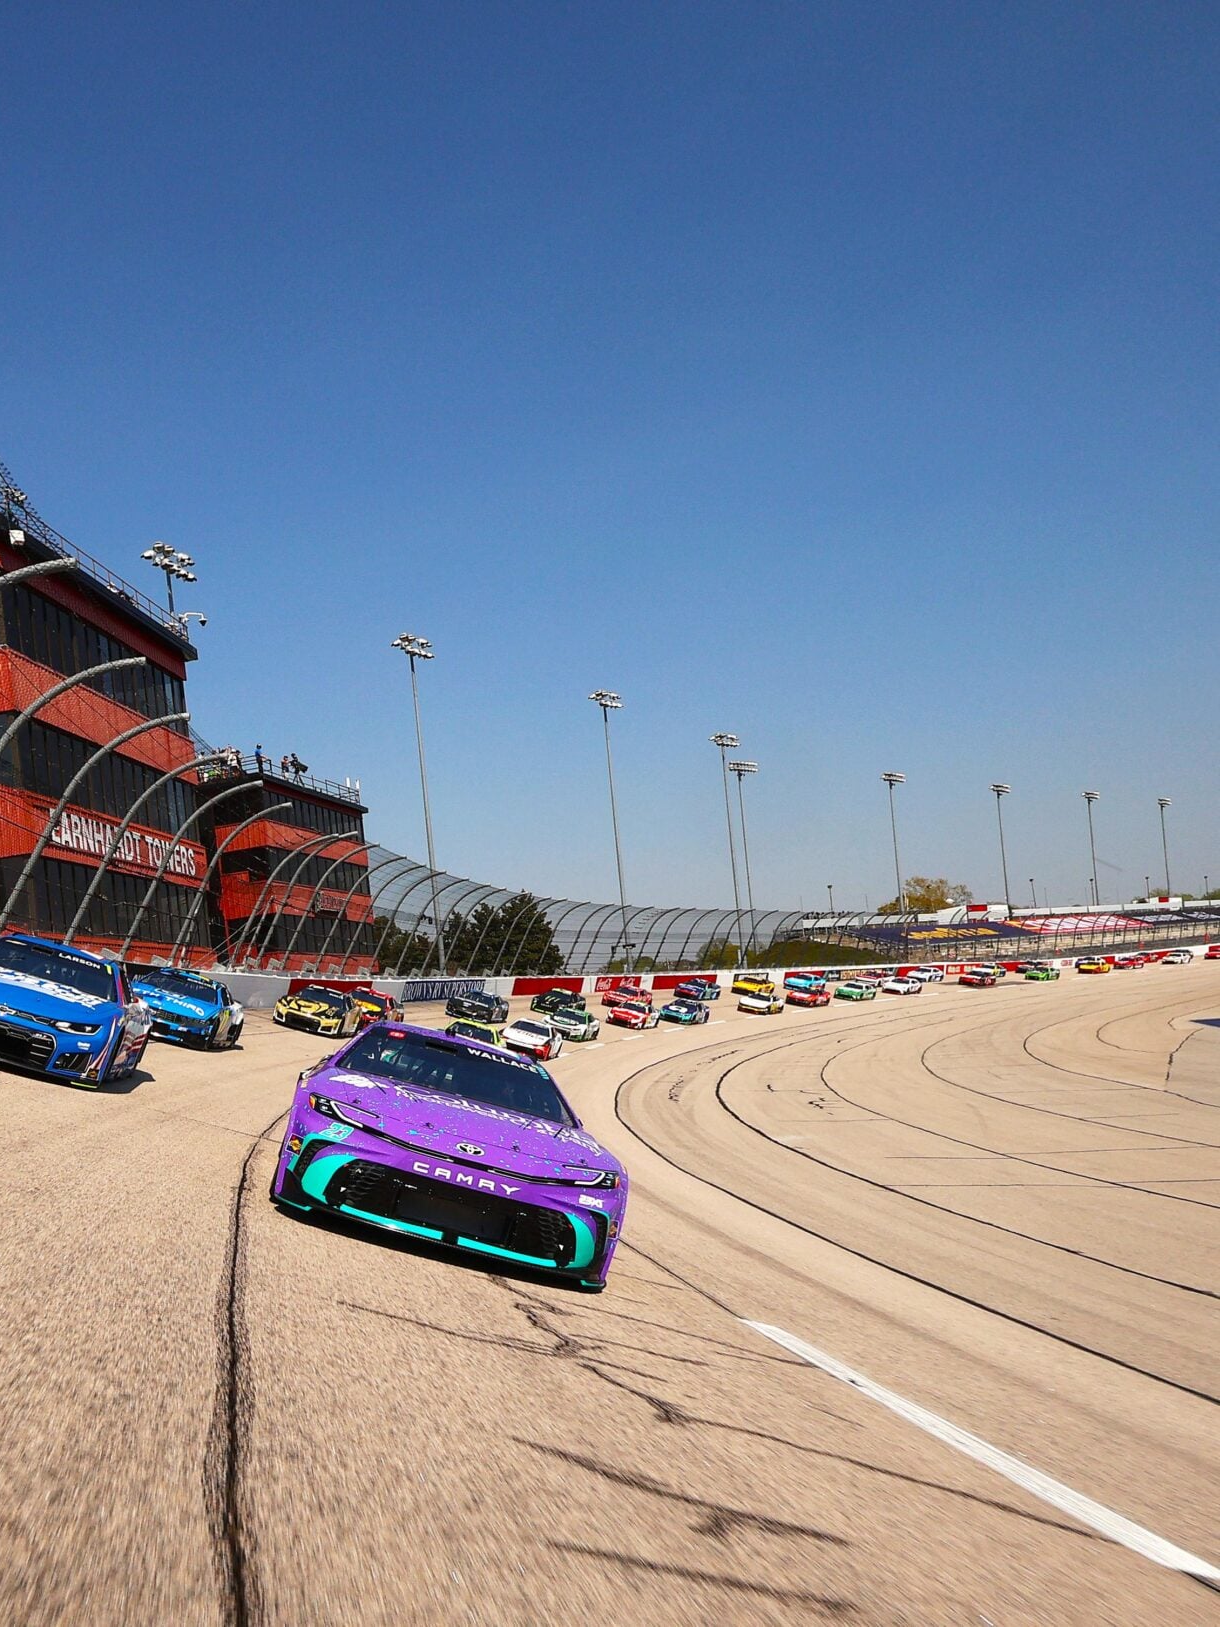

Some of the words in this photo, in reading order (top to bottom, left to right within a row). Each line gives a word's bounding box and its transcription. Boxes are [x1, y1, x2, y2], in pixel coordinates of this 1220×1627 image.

[58, 952, 101, 970] LARSON
[164, 996, 205, 1017] THIRD
[467, 1048, 538, 1074] WALLACE
[319, 1122, 354, 1141] 23
[413, 1161, 521, 1195] CAMRY
